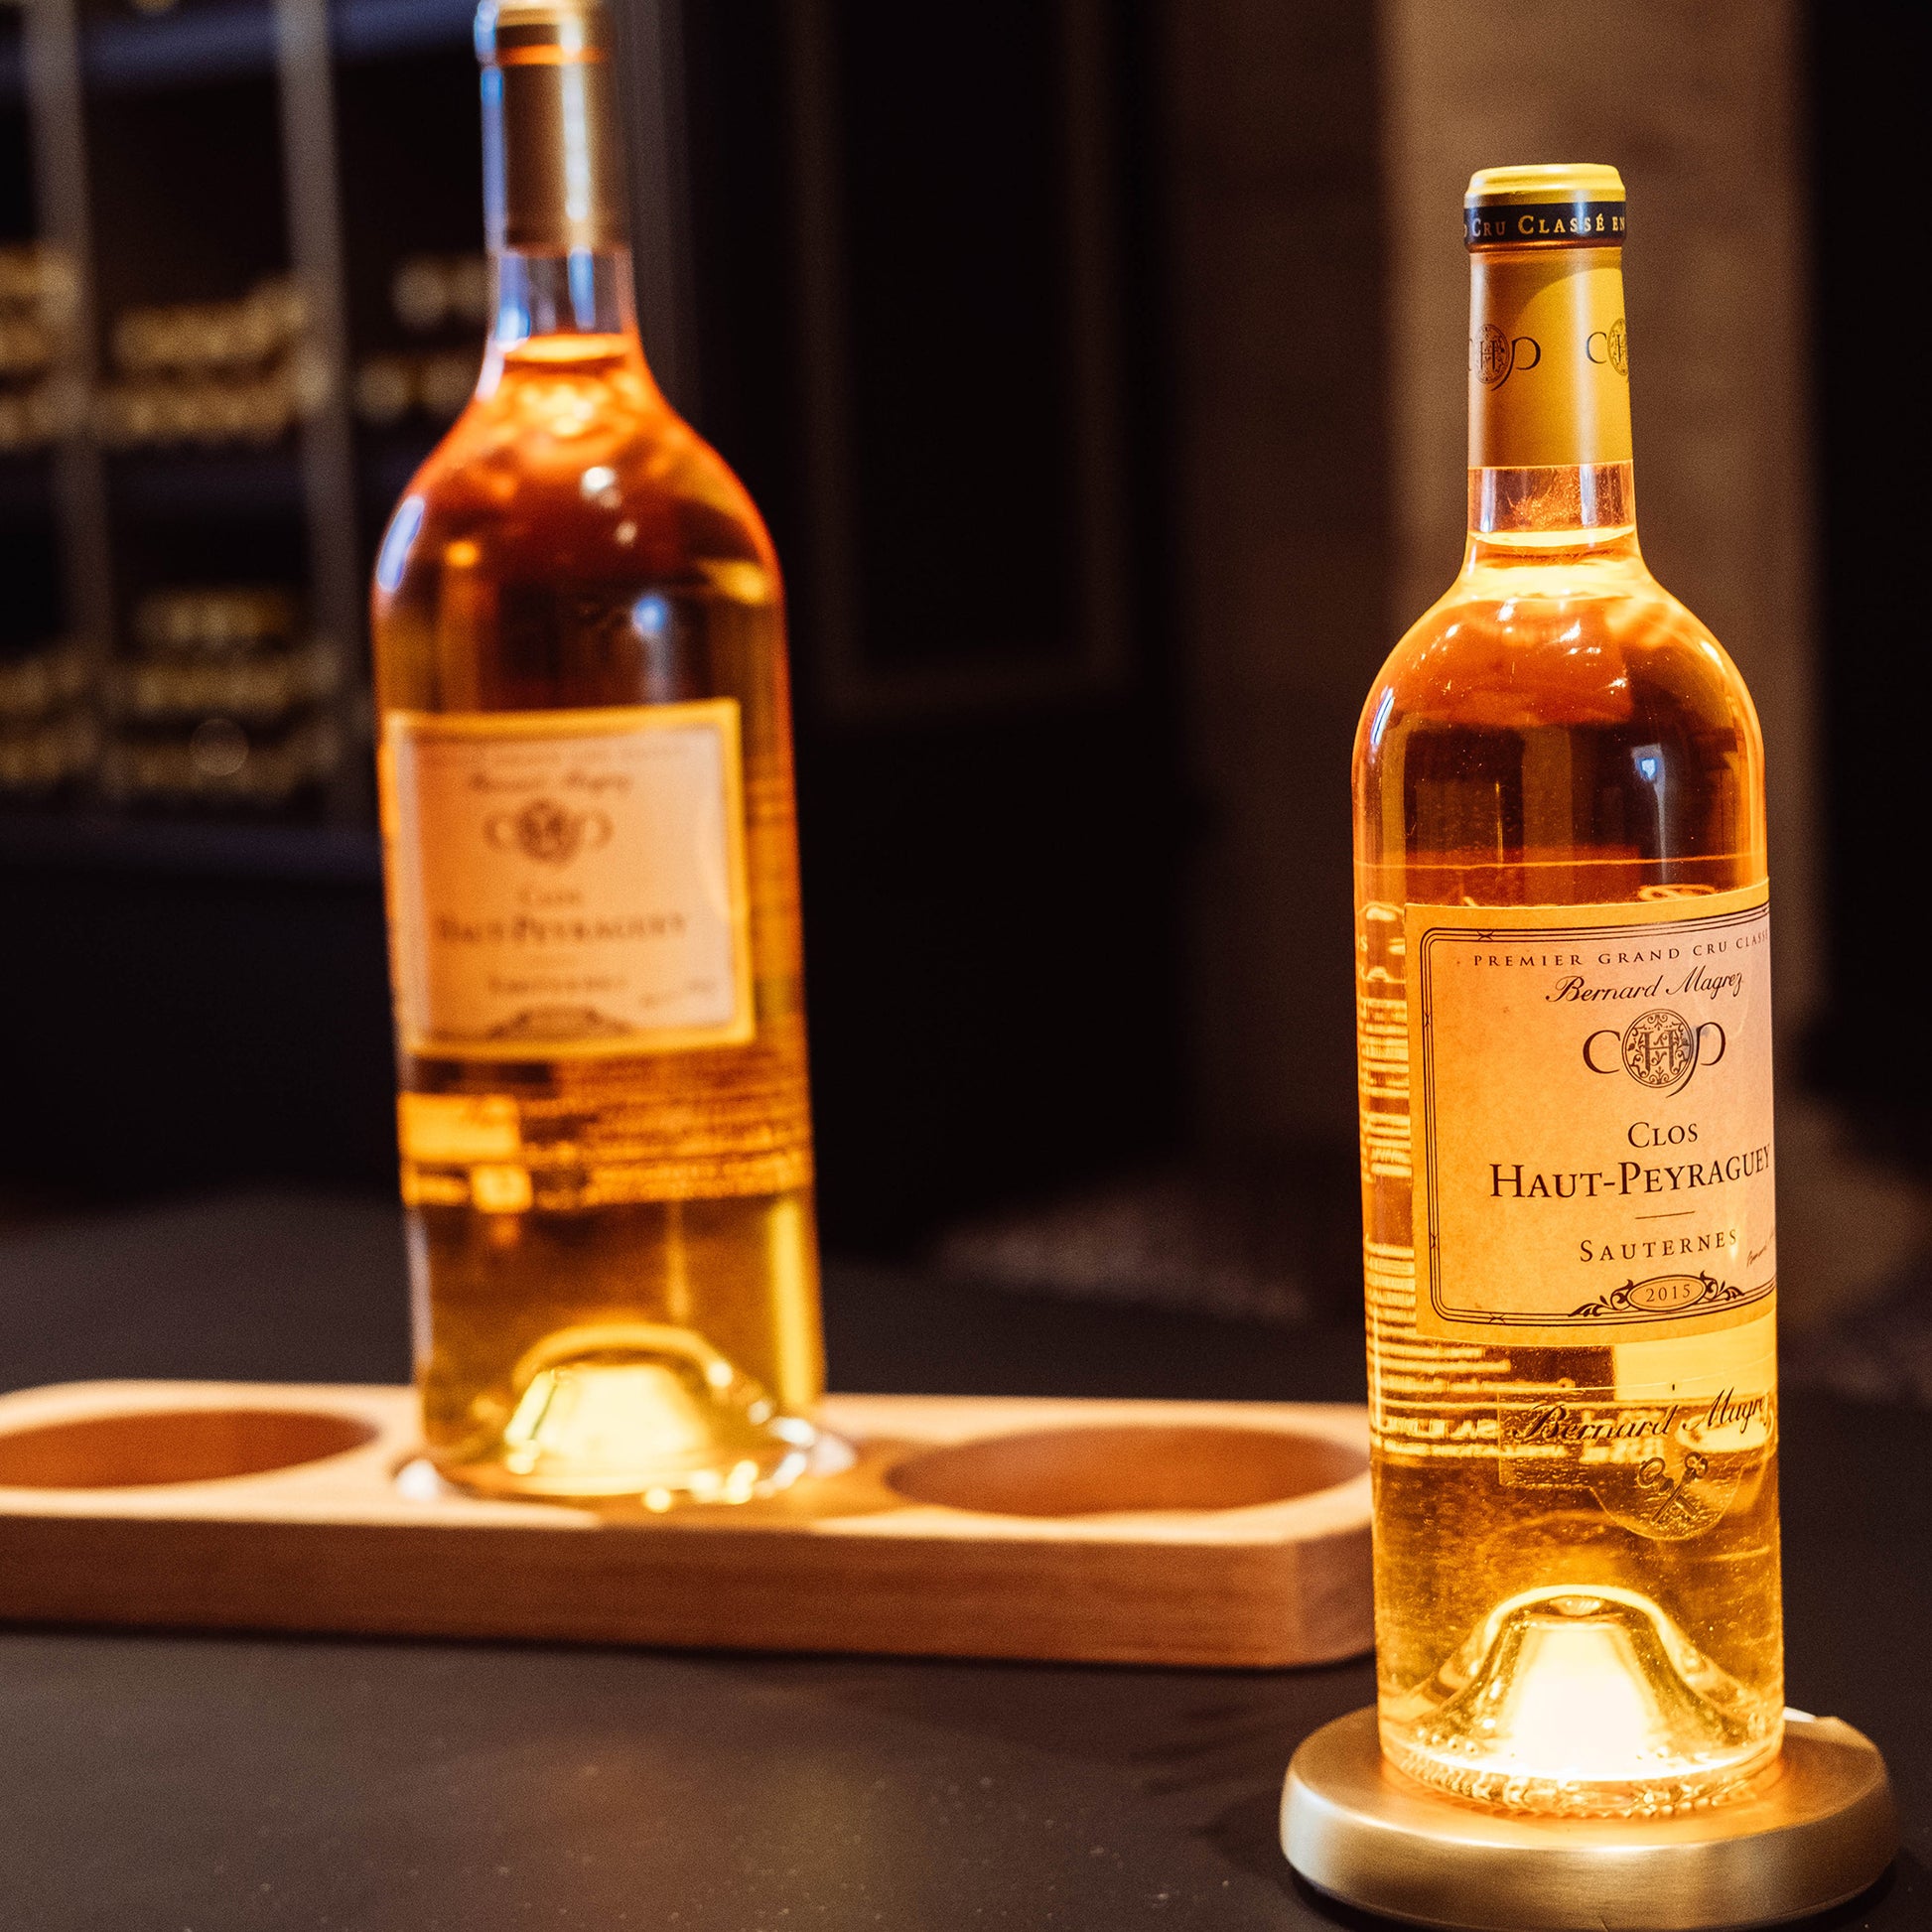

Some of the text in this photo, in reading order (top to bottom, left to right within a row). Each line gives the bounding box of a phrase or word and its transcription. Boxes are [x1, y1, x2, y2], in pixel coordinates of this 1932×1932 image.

[1471, 217, 1506, 237] CRU
[1518, 212, 1605, 235] CLASSÉ
[1473, 954, 1583, 968] PREMIER
[1597, 947, 1681, 966] GRAND
[1692, 940, 1727, 957] CRU
[1545, 965, 1743, 1003] Bernard Magrez
[1579, 1228, 1737, 1263] SAUTERNES
[1644, 1283, 1692, 1304] 2015
[1511, 1404, 1679, 1442] Bernard
